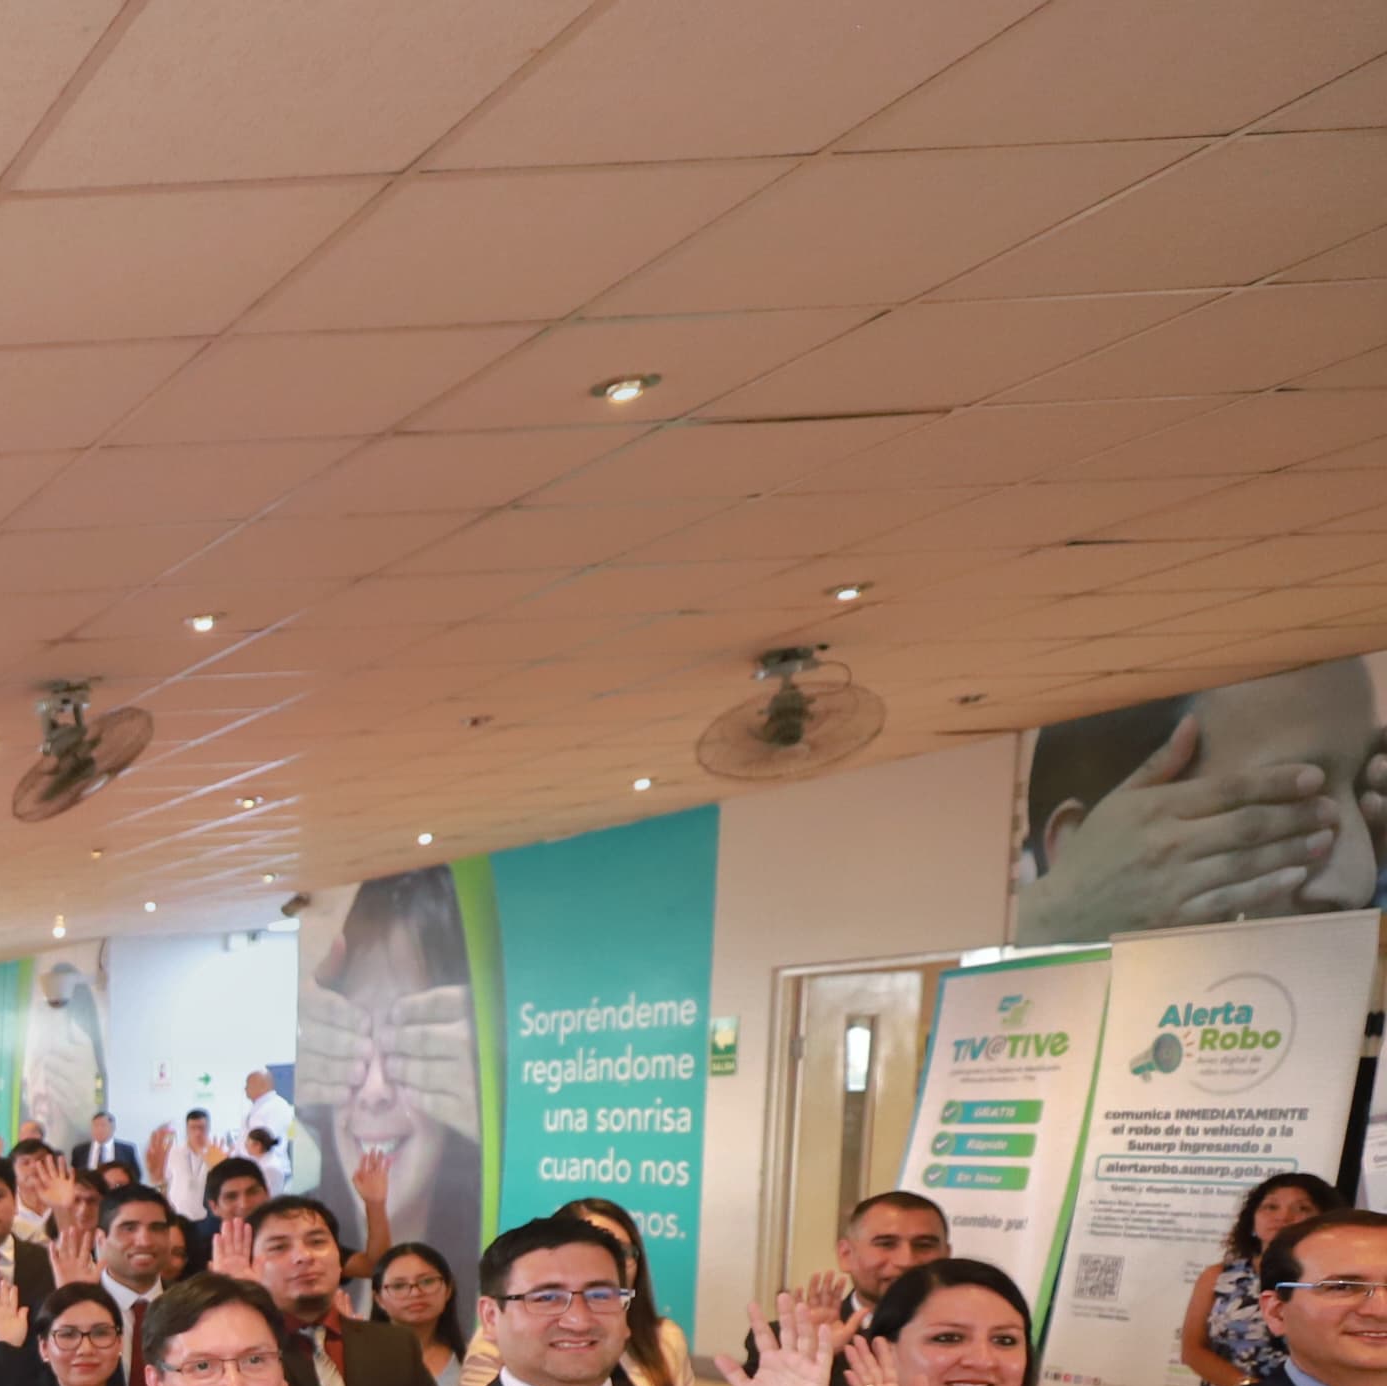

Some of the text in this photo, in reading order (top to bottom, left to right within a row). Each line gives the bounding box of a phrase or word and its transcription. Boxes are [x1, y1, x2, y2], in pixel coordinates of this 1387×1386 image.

[520, 993, 697, 1044] Sorpréndeme
[1158, 1001, 1254, 1027] Alerta
[1199, 1026, 1282, 1051] Robo
[522, 1044, 695, 1093] regalándome
[543, 1097, 692, 1133] una sonrisa
[1105, 1108, 1309, 1121] comunica INMEDIATAMENTE
[1112, 1124, 1125, 1135] el
[1128, 1124, 1162, 1136] robo
[1165, 1125, 1182, 1136] de
[1185, 1125, 1200, 1137] tu
[1267, 1127, 1277, 1138] a
[1280, 1126, 1294, 1138] la
[1127, 1139, 1273, 1155] Sunarp ingresando a
[538, 1148, 690, 1187] cuando nos
